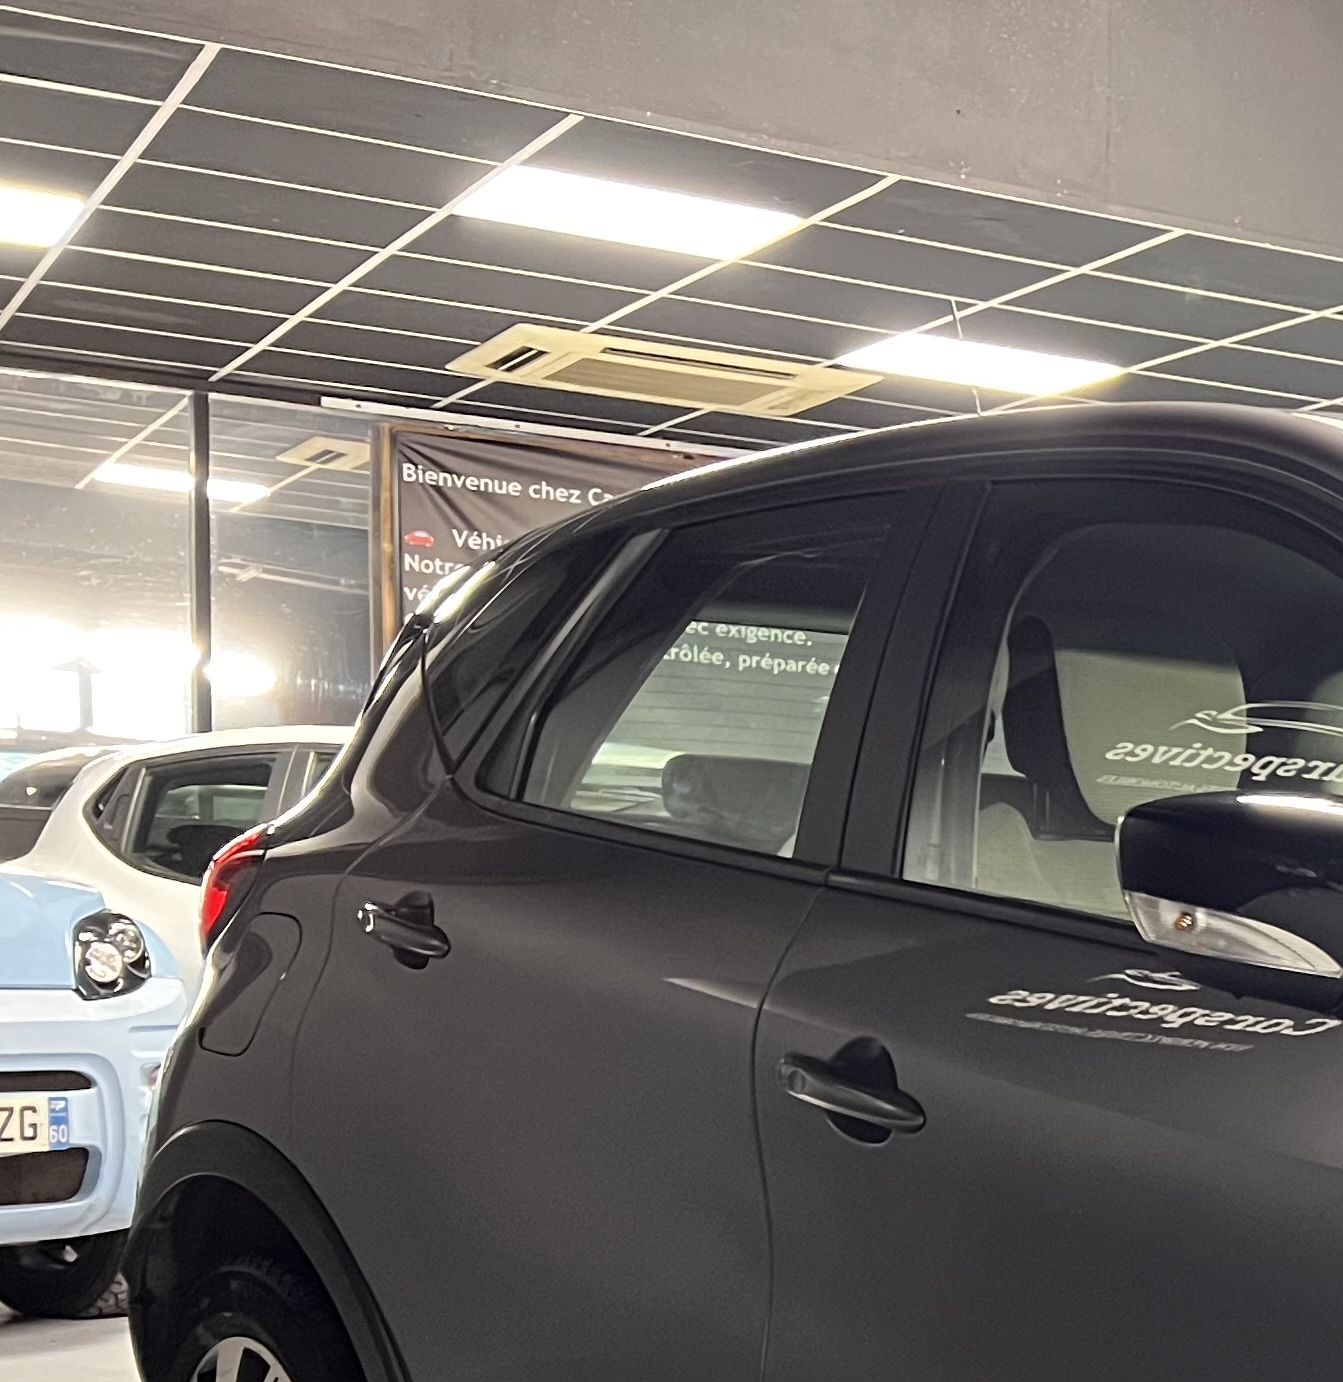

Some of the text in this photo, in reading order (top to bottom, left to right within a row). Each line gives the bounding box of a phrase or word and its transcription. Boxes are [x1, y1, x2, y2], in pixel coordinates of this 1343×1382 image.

[402, 463, 522, 496] Bienvenue
[528, 481, 582, 504] chez
[452, 528, 511, 550] Véhi
[715, 623, 813, 646] exigence.
[738, 653, 830, 676] préparée
[0, 1105, 38, 1142] ZG
[49, 1124, 68, 1144] 60
